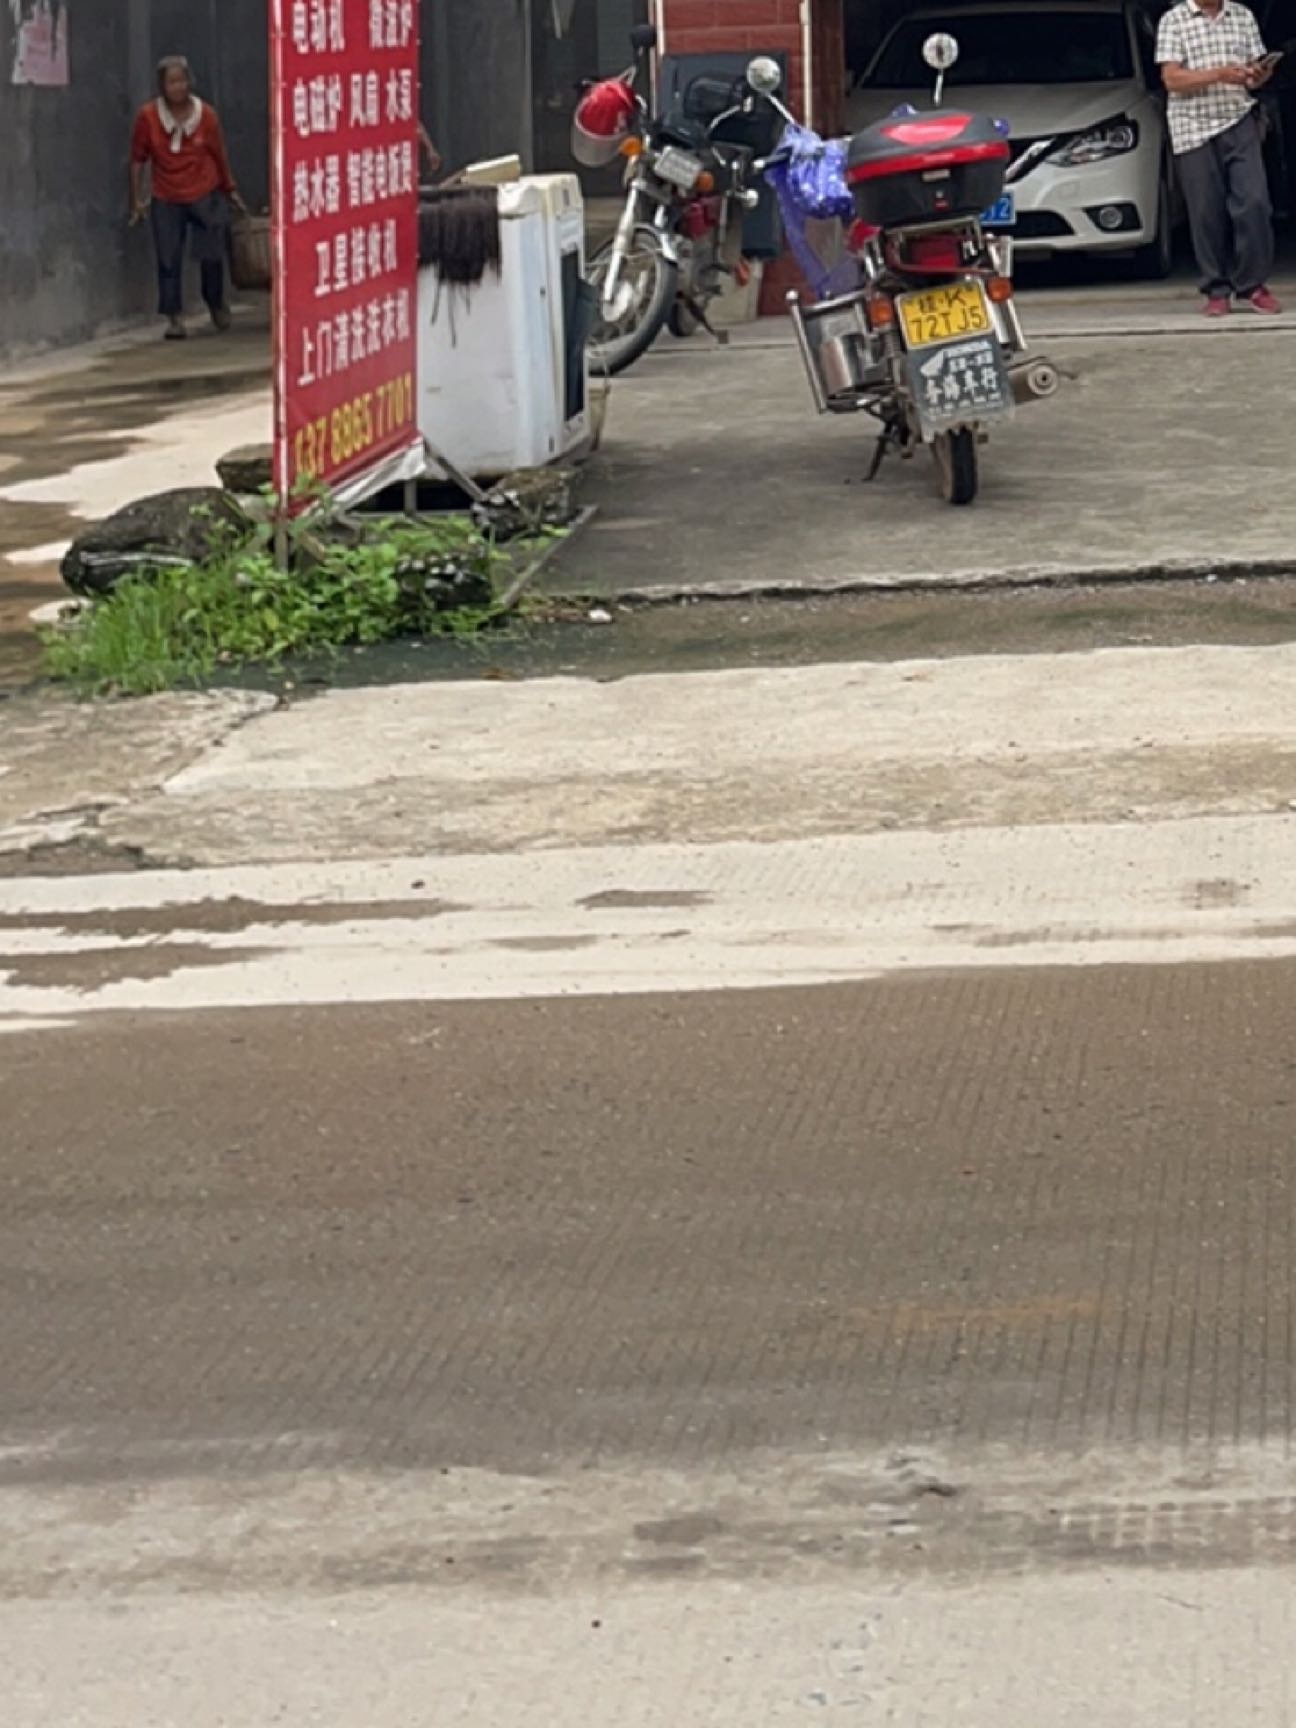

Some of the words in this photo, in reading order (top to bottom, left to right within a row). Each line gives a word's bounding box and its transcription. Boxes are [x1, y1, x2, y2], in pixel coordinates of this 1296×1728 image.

[313, 218, 398, 298] 卫星接收机
[908, 306, 983, 342] 72TJ5
